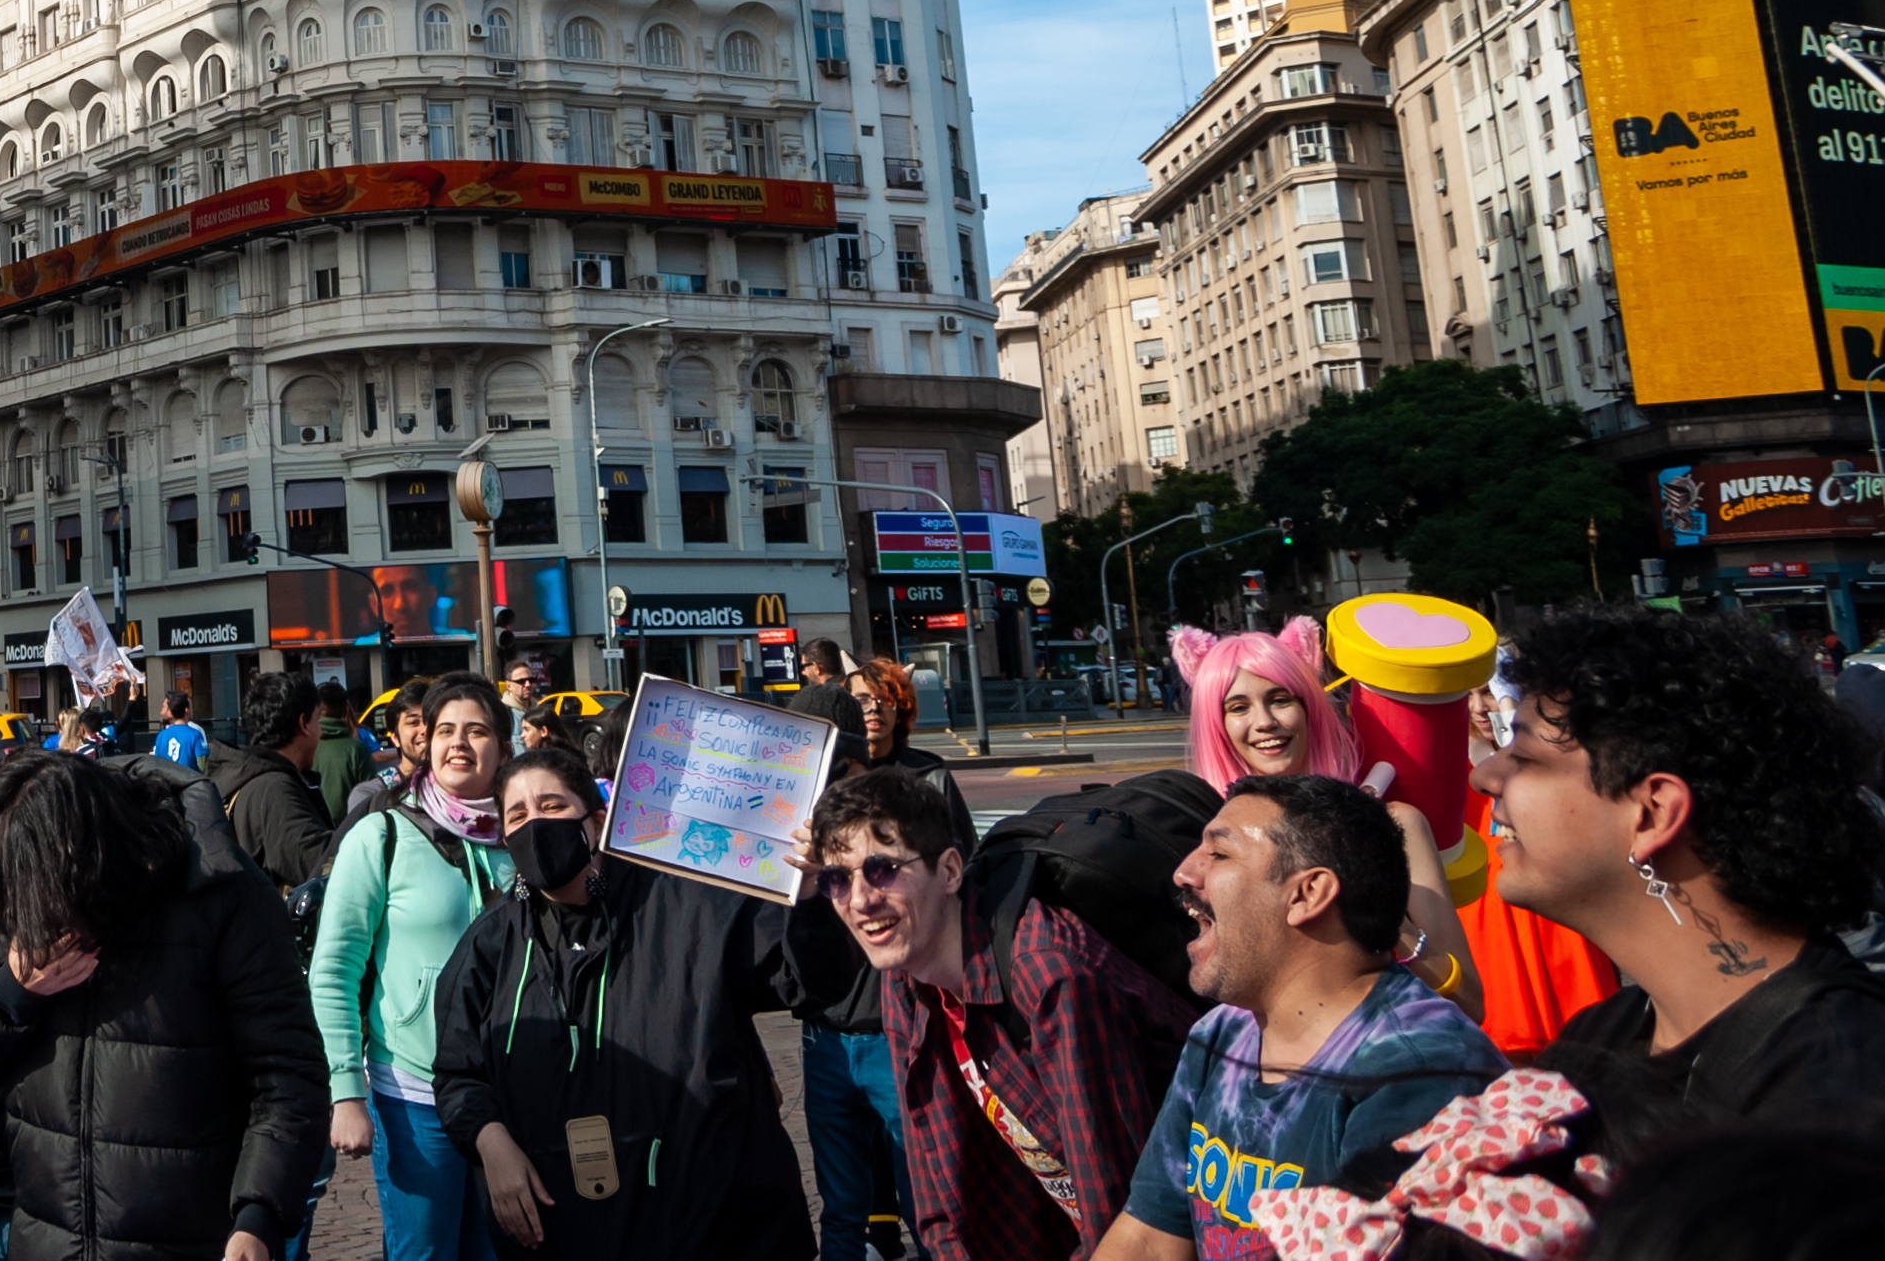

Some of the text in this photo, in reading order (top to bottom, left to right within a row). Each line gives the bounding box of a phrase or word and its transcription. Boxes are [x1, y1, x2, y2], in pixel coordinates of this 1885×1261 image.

[1687, 108, 1740, 123] Buenos
[1699, 120, 1737, 133] Aires
[1613, 112, 1700, 158] BA
[1704, 126, 1756, 142] Ciudad
[1817, 128, 1885, 165] al 91
[588, 180, 641, 197] McCOMBO
[668, 182, 710, 200] GRAND
[713, 183, 763, 202] LEYENDA
[1636, 168, 1748, 191] Vamos por más
[195, 198, 270, 230] PASAN COSAS LINDAS
[1719, 475, 1813, 503] NUEVAS
[632, 607, 744, 627] McDonald's
[170, 624, 238, 647] McDonald's
[638, 740, 656, 760] LA
[775, 778, 797, 791] EN
[1193, 1198, 1213, 1222] THE
